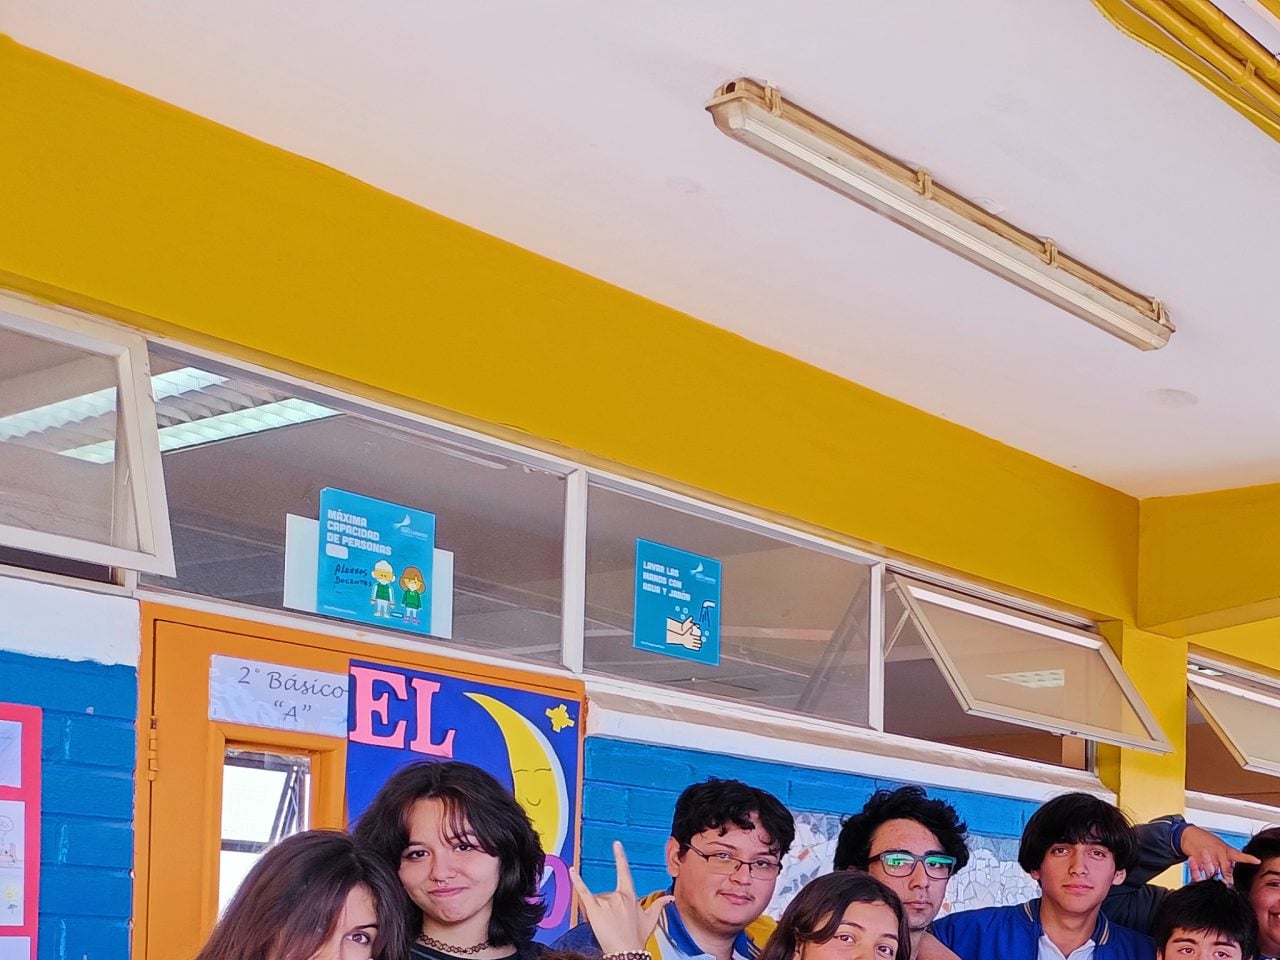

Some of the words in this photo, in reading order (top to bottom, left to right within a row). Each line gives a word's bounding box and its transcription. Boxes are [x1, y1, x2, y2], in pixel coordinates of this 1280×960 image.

[327, 508, 367, 527] MÁXIMA
[327, 520, 380, 541] CAPACIDAD
[326, 532, 340, 543] DE
[341, 535, 392, 555] PERSONAS
[643, 560, 665, 574] LAVAR
[666, 566, 680, 577] LAS
[662, 587, 668, 596] Y
[668, 578, 682, 589] CON
[268, 671, 349, 699] Básico
[349, 666, 456, 759] EL
